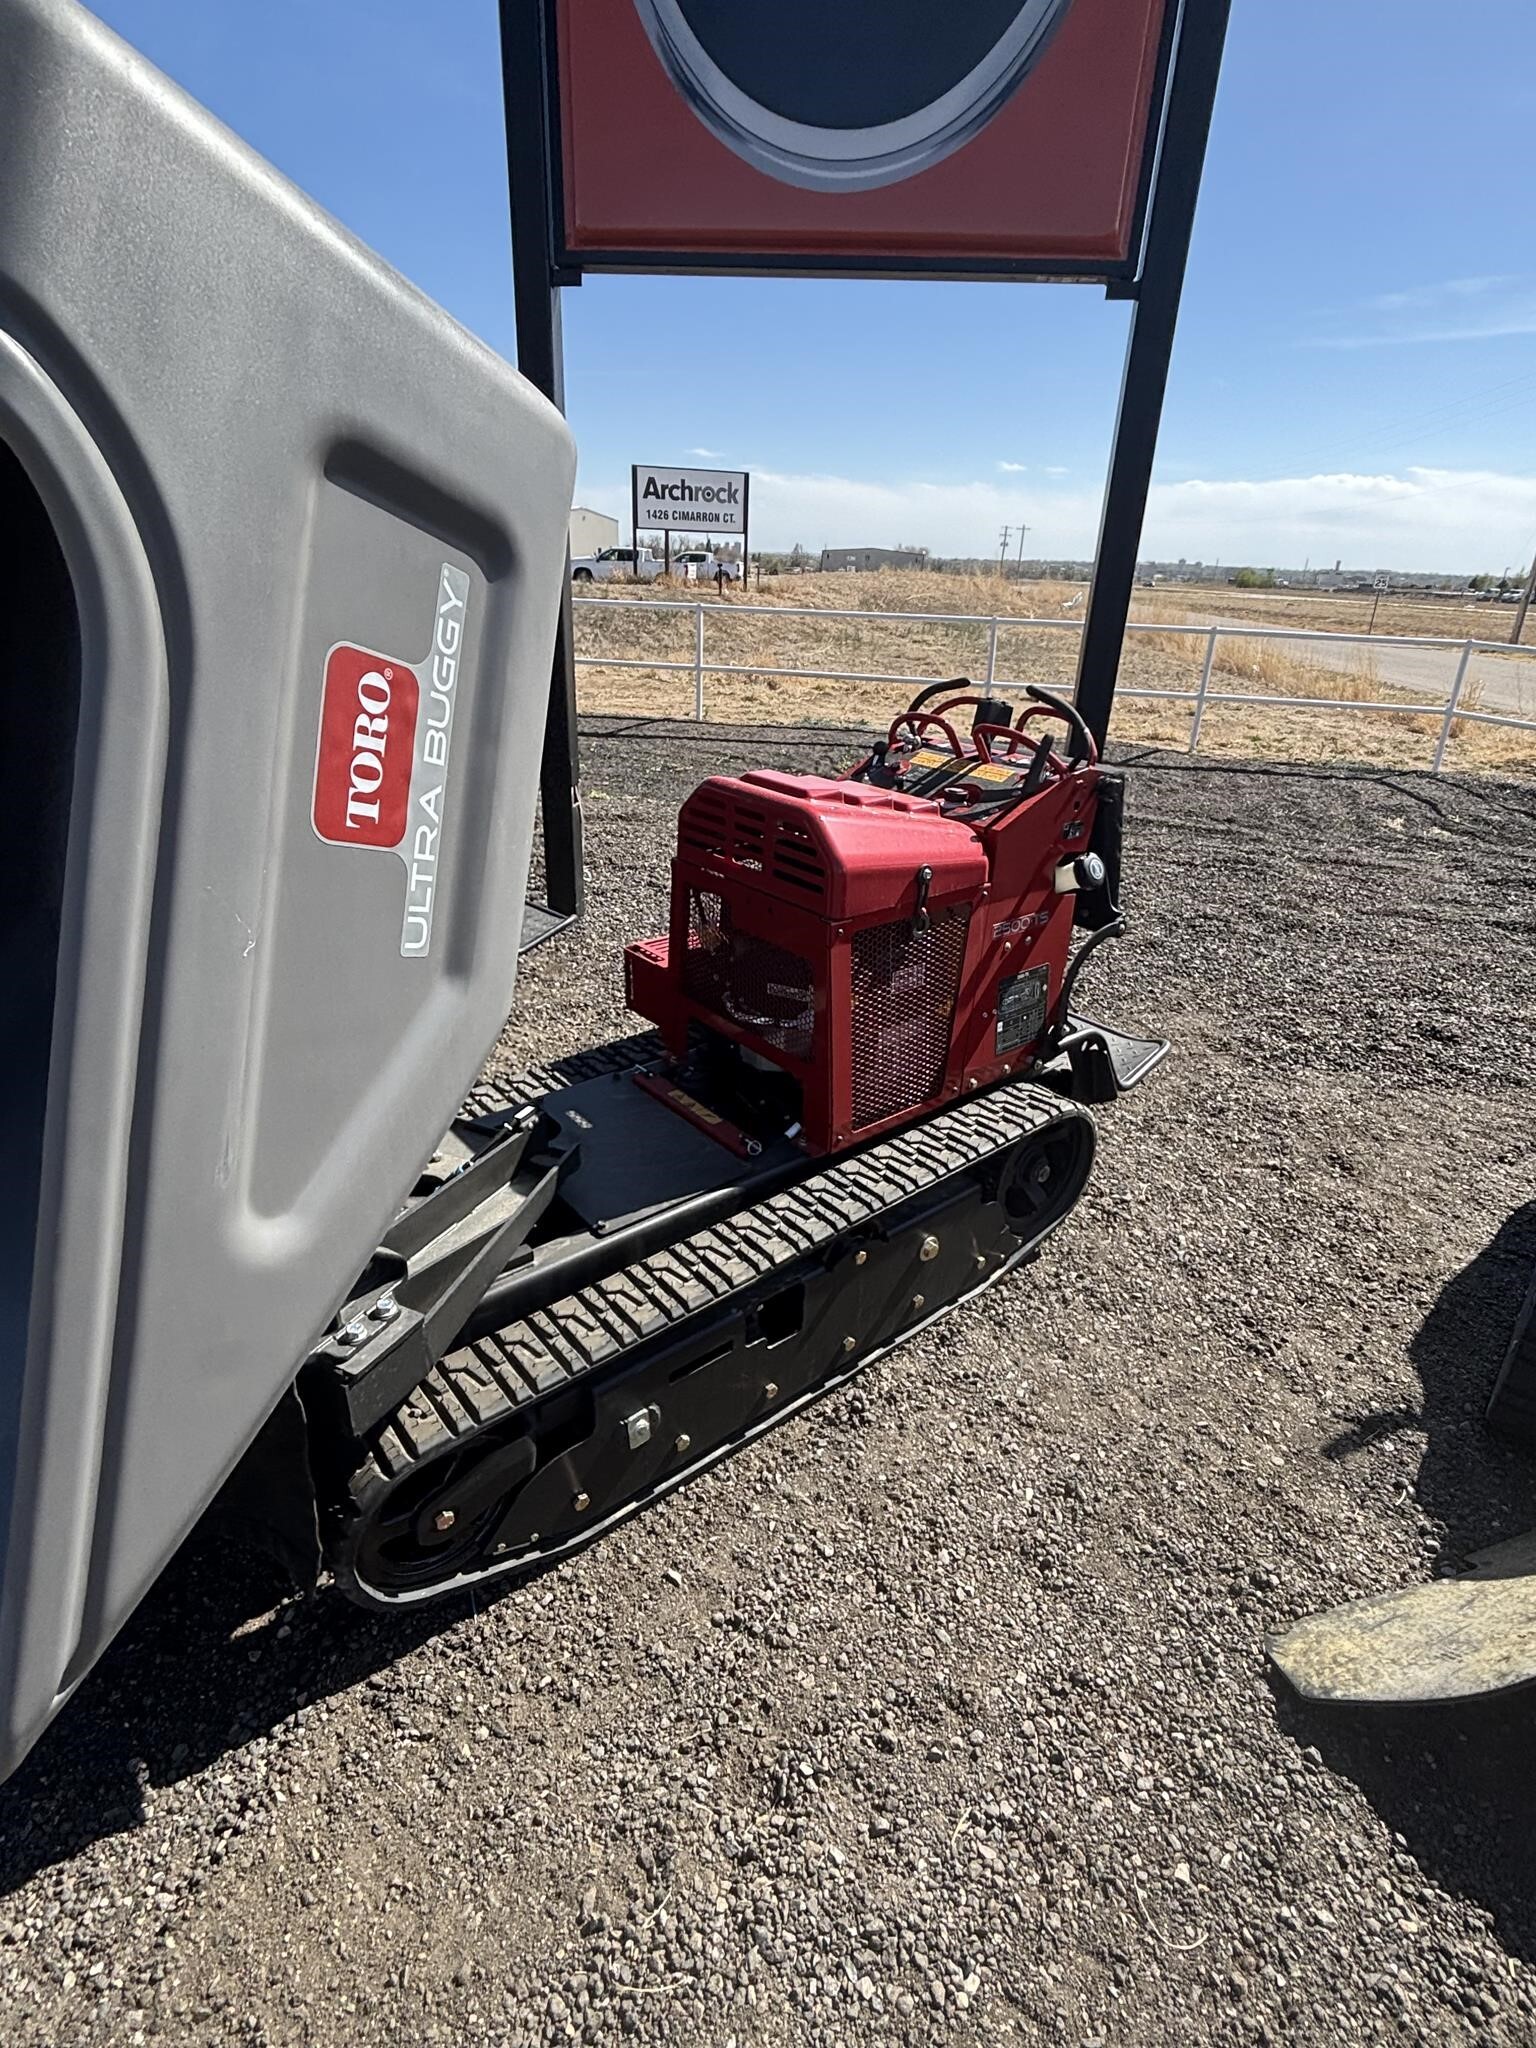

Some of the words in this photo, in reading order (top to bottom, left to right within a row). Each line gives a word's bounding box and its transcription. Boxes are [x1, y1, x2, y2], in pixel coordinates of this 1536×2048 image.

[643, 476, 739, 504] Archrock
[646, 509, 669, 521] 1426
[672, 510, 720, 523] CIMARRON
[723, 512, 736, 523] CT.
[1375, 579, 1387, 587] 25
[422, 576, 464, 766] BUGGY
[404, 784, 442, 950] ULTRA
